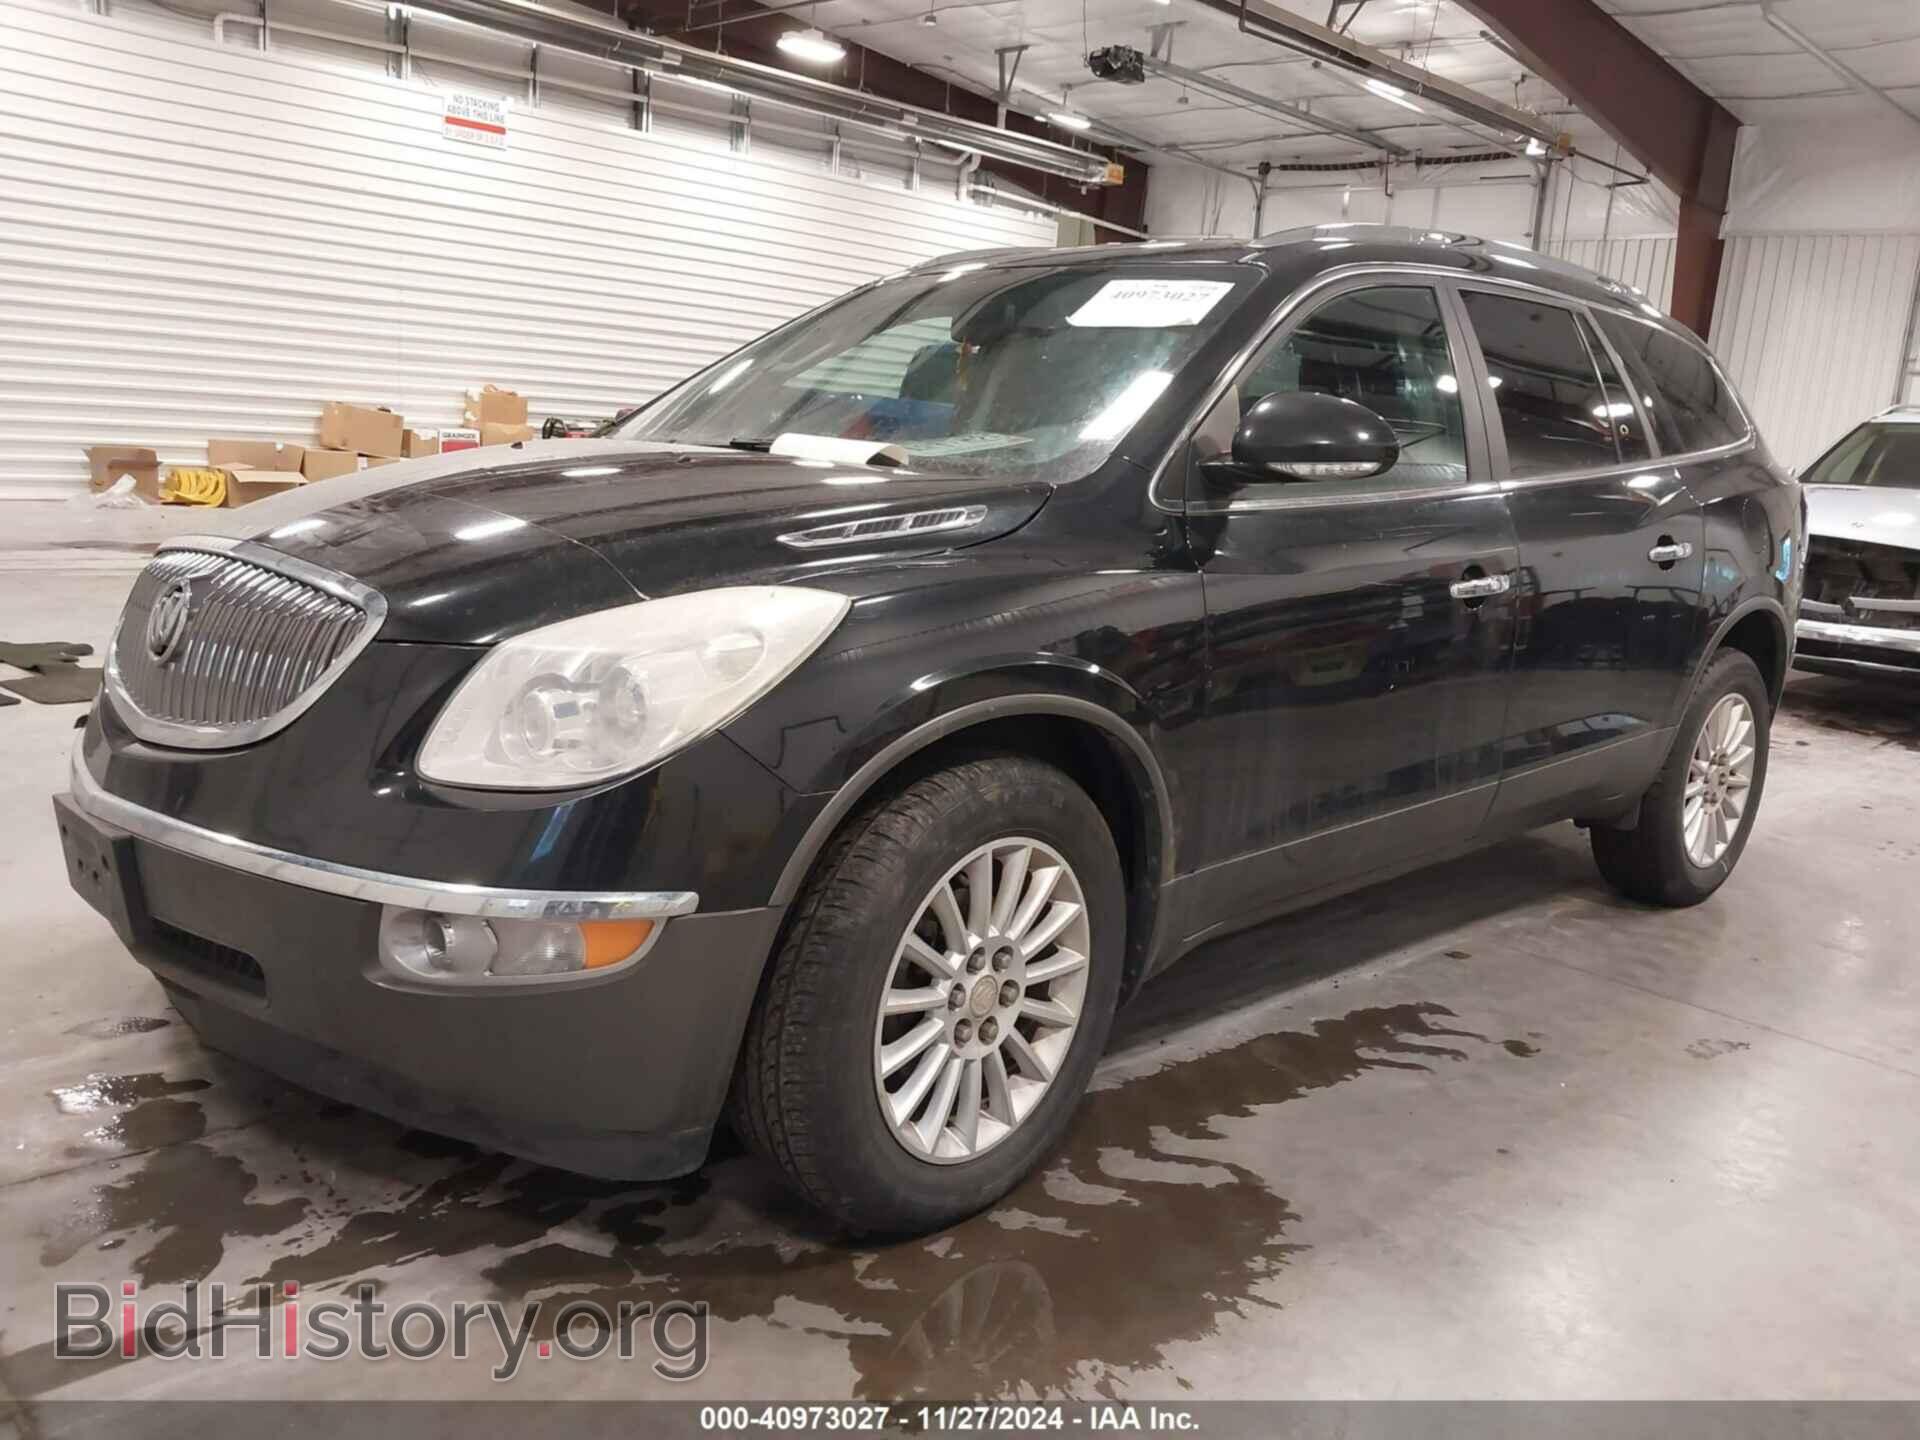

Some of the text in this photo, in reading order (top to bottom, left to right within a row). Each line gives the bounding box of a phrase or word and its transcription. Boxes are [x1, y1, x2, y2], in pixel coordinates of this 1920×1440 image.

[453, 94, 500, 112] NO STACKING
[447, 104, 505, 124] ABOVE THIS LINE
[1110, 289, 1212, 302] 40973027
